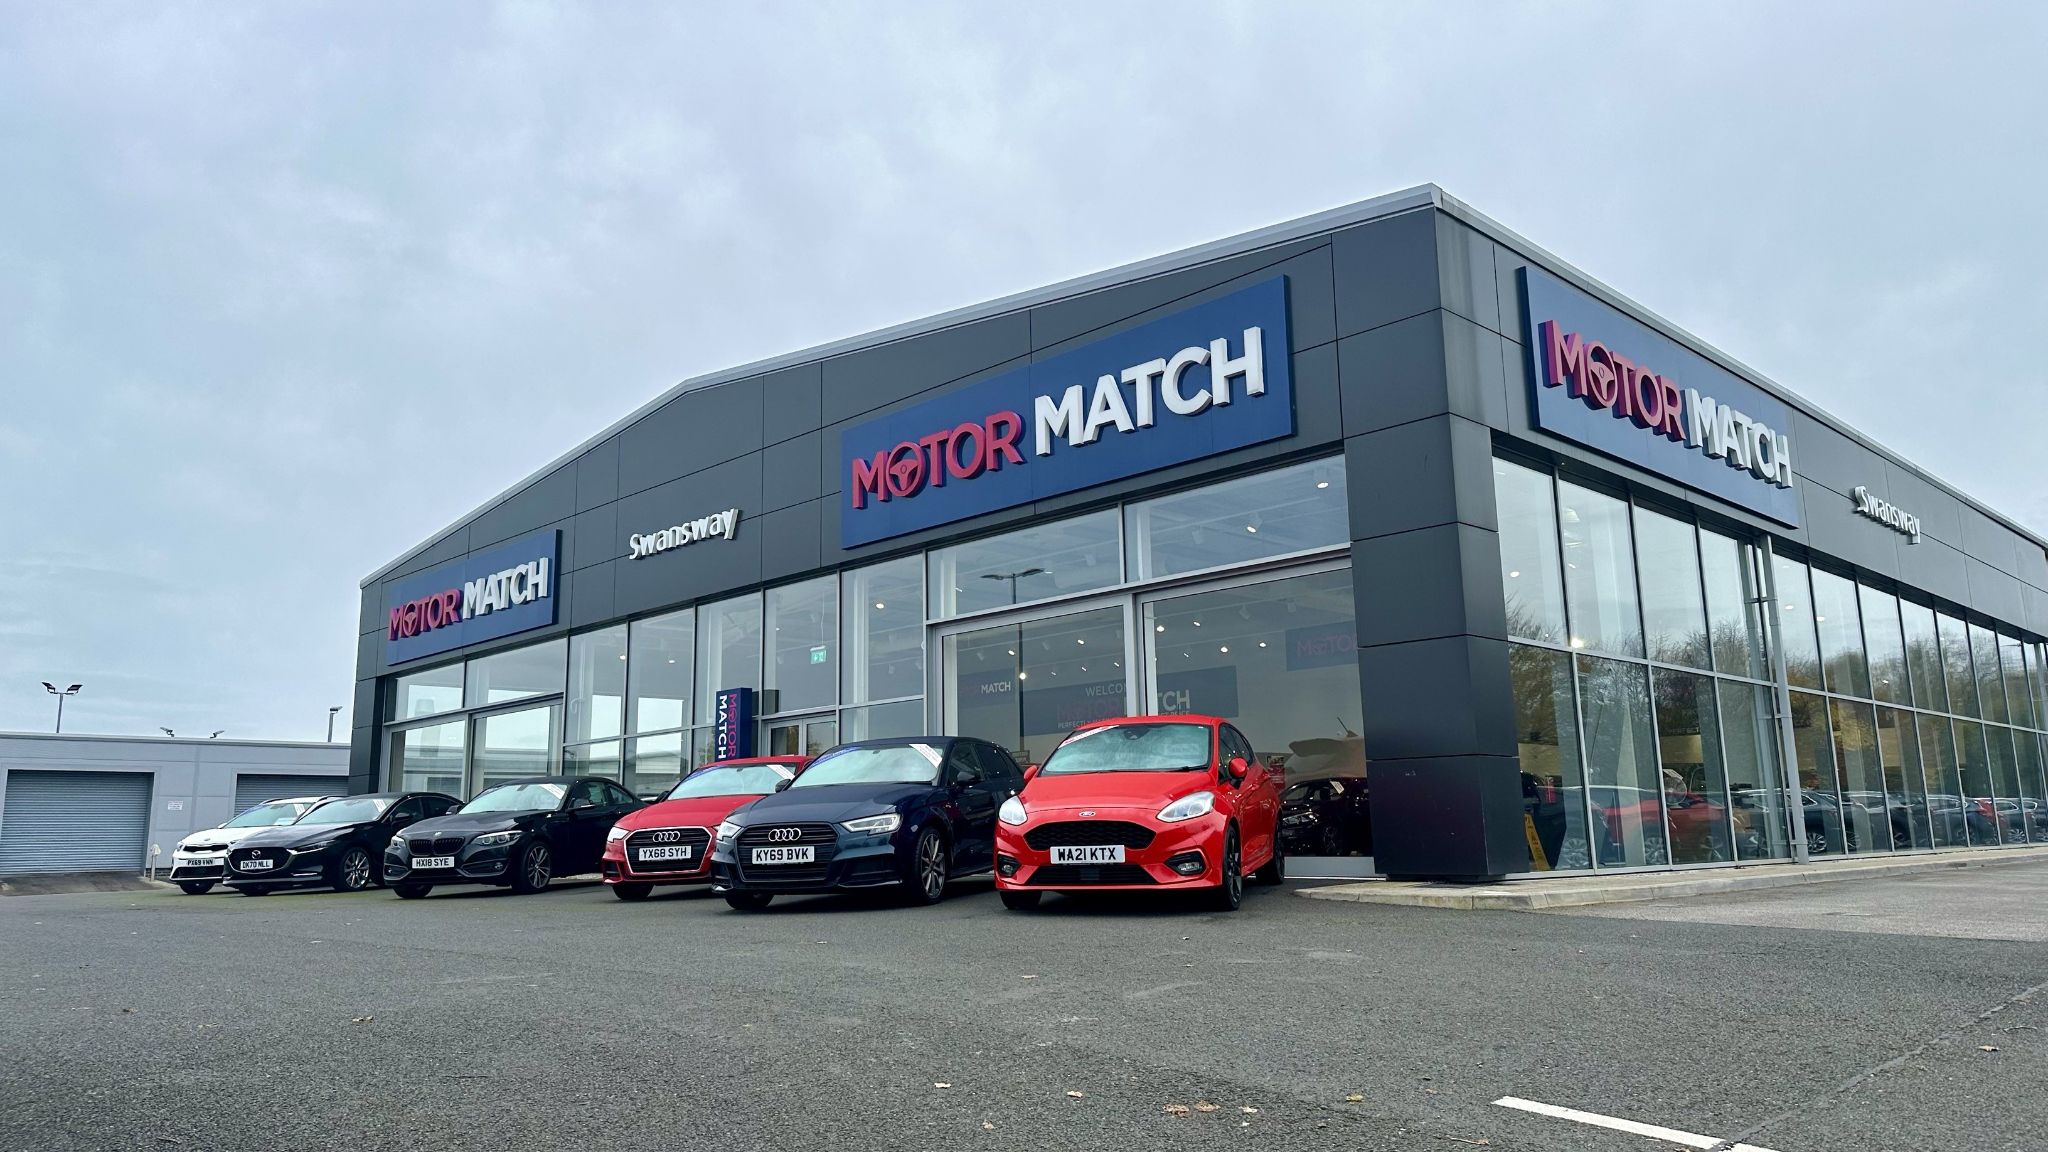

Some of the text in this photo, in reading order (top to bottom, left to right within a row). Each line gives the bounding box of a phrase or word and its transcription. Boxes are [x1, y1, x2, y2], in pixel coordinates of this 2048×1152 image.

[852, 326, 1265, 509] MOTOR MATCH
[1539, 320, 1793, 489] MOTOR MATCH
[629, 508, 739, 560] Swansway
[1853, 486, 1921, 544] Swansway
[388, 557, 550, 641] MOTOR MATCH
[981, 681, 1011, 694] MATCH
[718, 694, 727, 759] MATCH
[728, 693, 737, 757] MOTOR
[433, 858, 449, 866] SYE
[642, 847, 687, 859] YX68 SYH
[755, 848, 809, 862] KY69 BVK
[1057, 847, 1116, 861] WA21 KTX
